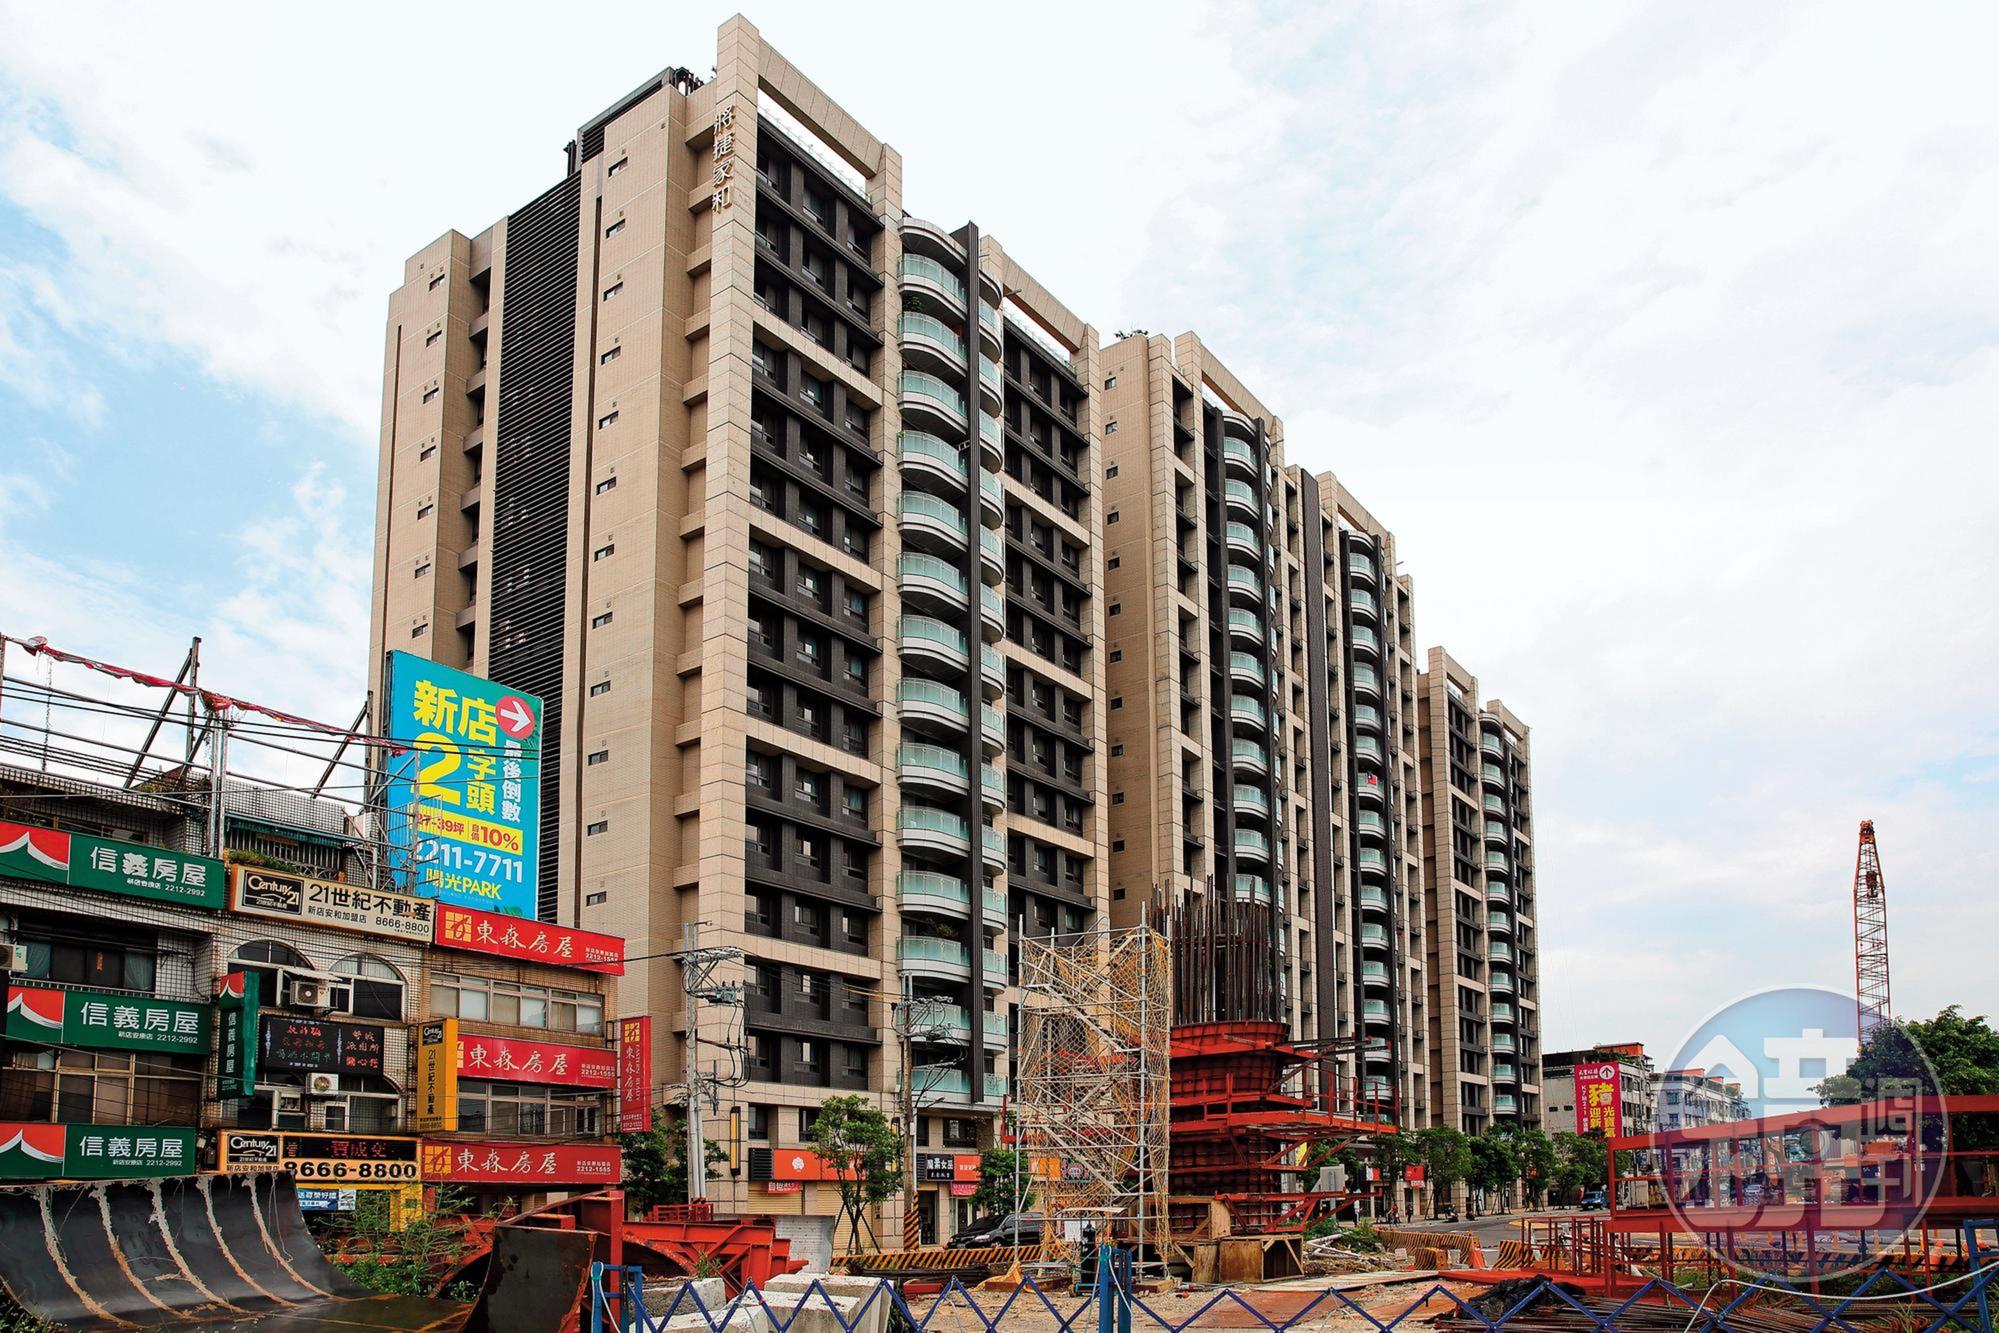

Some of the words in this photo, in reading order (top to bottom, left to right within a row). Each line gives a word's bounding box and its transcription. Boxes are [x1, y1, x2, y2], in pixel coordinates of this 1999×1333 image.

[712, 104, 736, 214] 將捷家和
[413, 679, 500, 748] 新店
[410, 730, 462, 808] 2
[466, 748, 497, 816] 字頭
[501, 739, 523, 823] 最後倒數
[480, 825, 519, 851] 10%
[90, 846, 206, 887] 信義房屋
[248, 875, 292, 895] Century
[286, 891, 300, 906] 21
[426, 867, 502, 900] 陽光PARK
[308, 883, 431, 922] 21世紀不動產
[308, 905, 367, 924] 新店安和加盟店
[476, 919, 575, 958] 東森房屋
[80, 1001, 199, 1034] 信義房屋
[157, 1033, 198, 1044] 2212-2992
[225, 1012, 237, 1073] 信義房屋
[468, 1044, 569, 1075] 東森房屋
[624, 1045, 636, 1102] 東森房屋
[79, 1135, 183, 1158] 信義房屋
[230, 1136, 270, 1150] Century
[265, 1145, 277, 1157] 21
[456, 1148, 561, 1174] 東森房屋
[283, 1161, 417, 1178] 8666-8800
